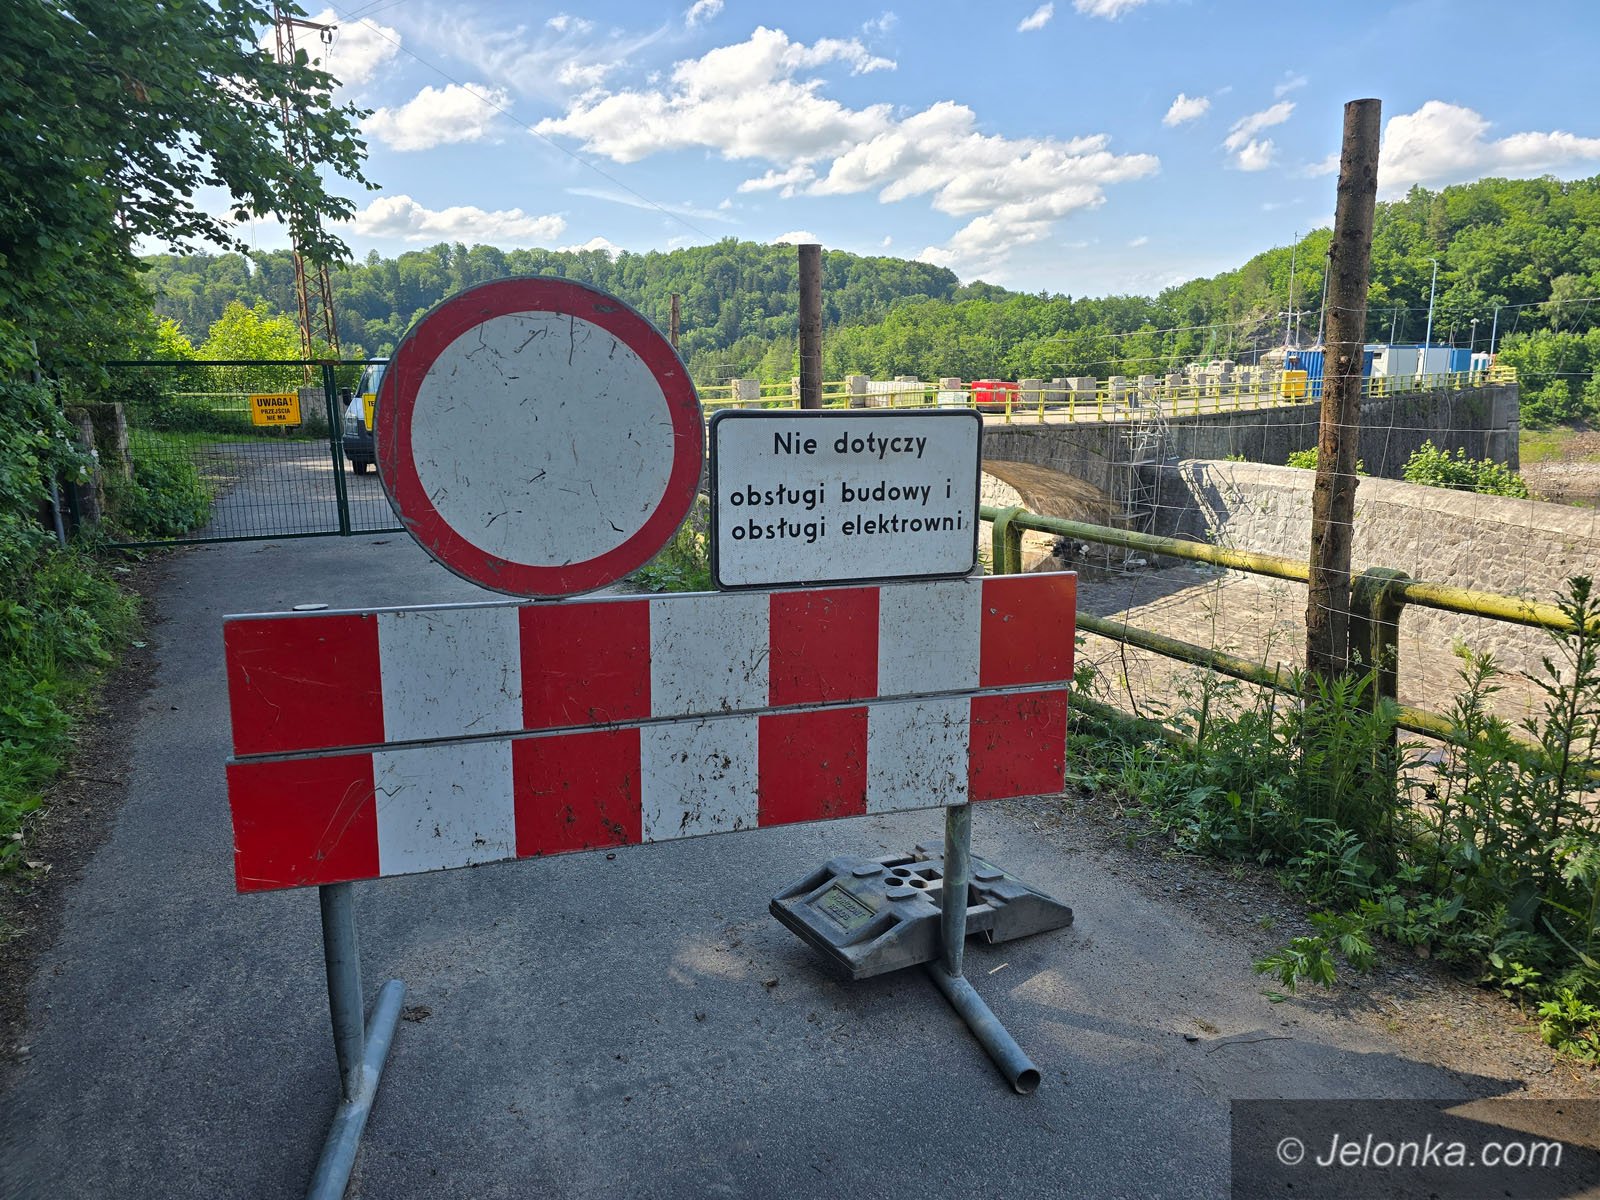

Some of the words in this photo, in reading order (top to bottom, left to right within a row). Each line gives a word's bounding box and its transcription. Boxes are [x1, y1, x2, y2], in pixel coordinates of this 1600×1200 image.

[774, 431, 818, 455] Nie
[833, 431, 927, 460] dotyczy
[730, 482, 825, 511] obsługi
[841, 480, 932, 506] budowy
[946, 478, 951, 499] i
[731, 515, 825, 544] obsługi
[841, 509, 962, 536] elektrowni
